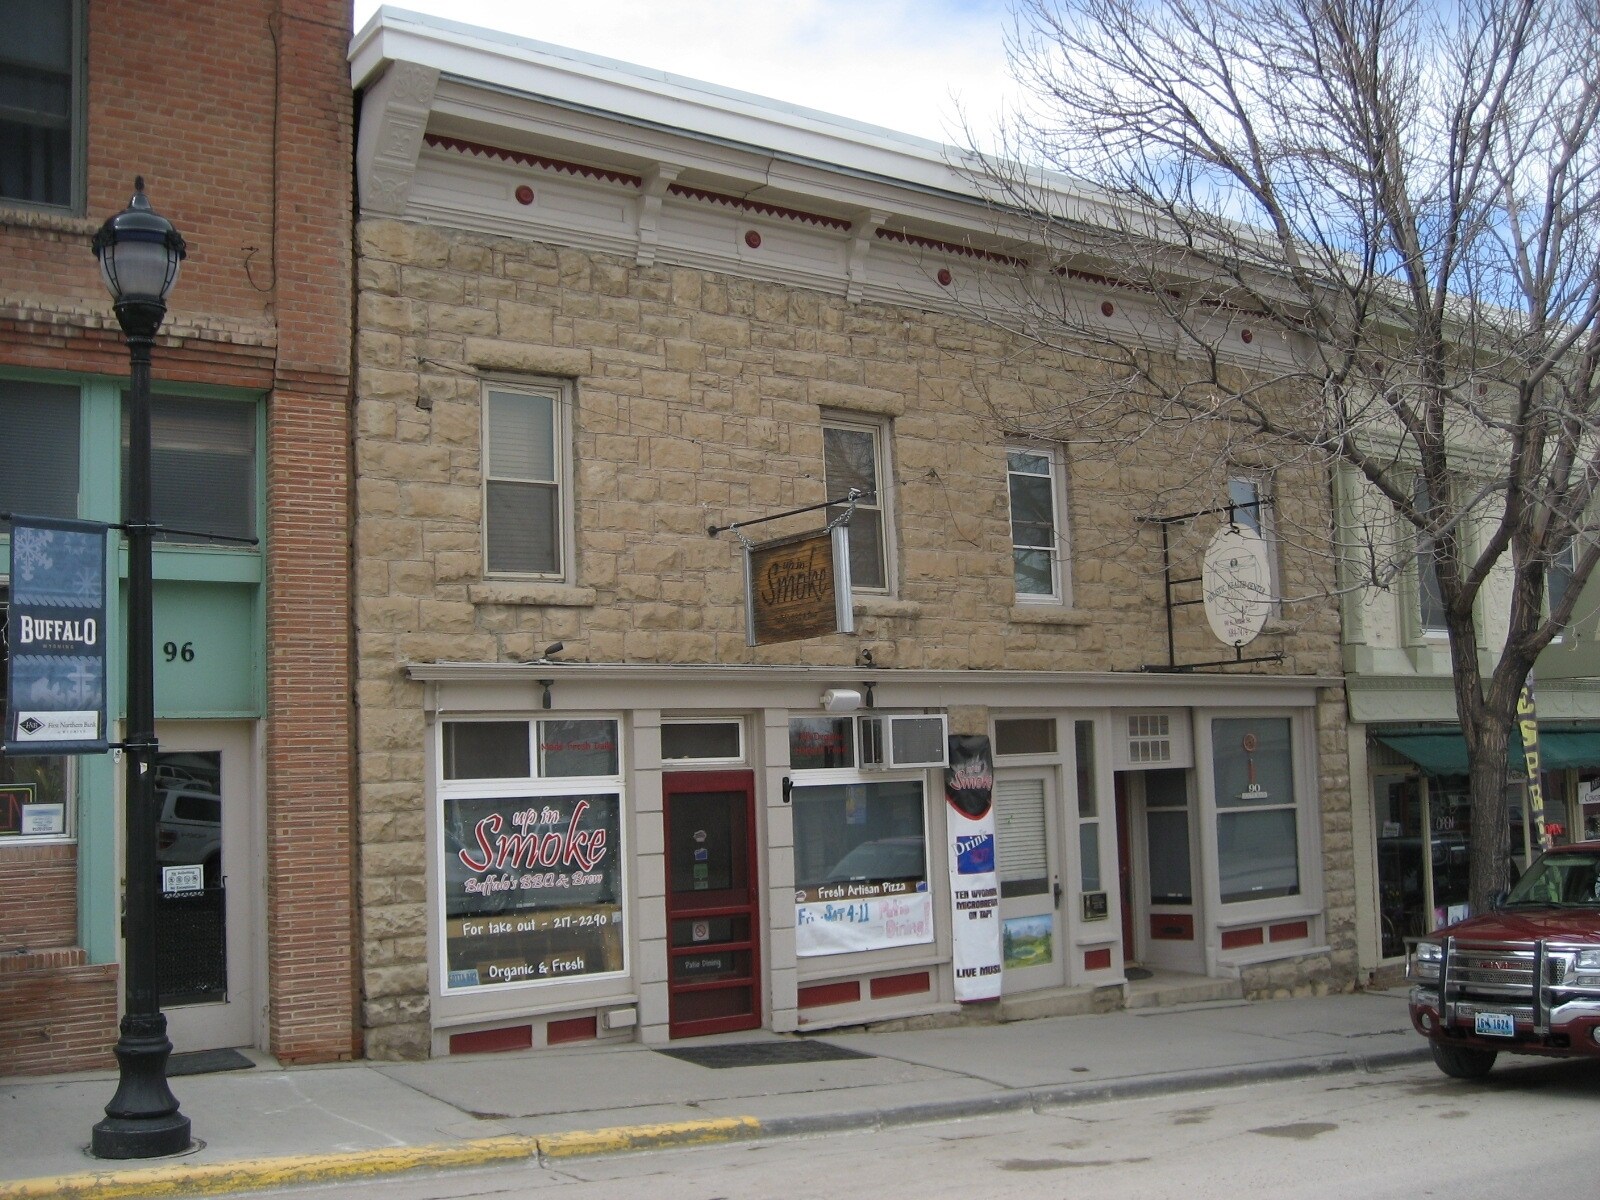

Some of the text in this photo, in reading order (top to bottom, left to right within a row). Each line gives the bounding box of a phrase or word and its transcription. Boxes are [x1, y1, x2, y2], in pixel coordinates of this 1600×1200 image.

[761, 546, 829, 605] Smoke
[20, 615, 97, 646] BUFFALO
[162, 641, 195, 663] 96
[60, 721, 83, 729] Northern
[1248, 784, 1261, 793] 90
[512, 806, 560, 836] up in
[1436, 816, 1454, 830] OPEN
[1545, 823, 1562, 835] OPEN
[459, 800, 606, 872] Smoke
[953, 834, 989, 857] Drink
[464, 871, 604, 896] Buffalo's BBQ & Brew
[817, 882, 906, 899] Fresh Artisan Pizza
[954, 890, 969, 900] TEN
[798, 908, 815, 926] Fri
[968, 911, 977, 920] ON
[463, 923, 484, 936] For
[489, 920, 513, 934] take
[517, 920, 535, 932] out
[553, 914, 607, 929] 217-2290
[488, 957, 585, 982] Organic & Fresh
[701, 959, 722, 969] Dining
[956, 968, 977, 979] LIVE
[1477, 1018, 1509, 1029] 16 1624
